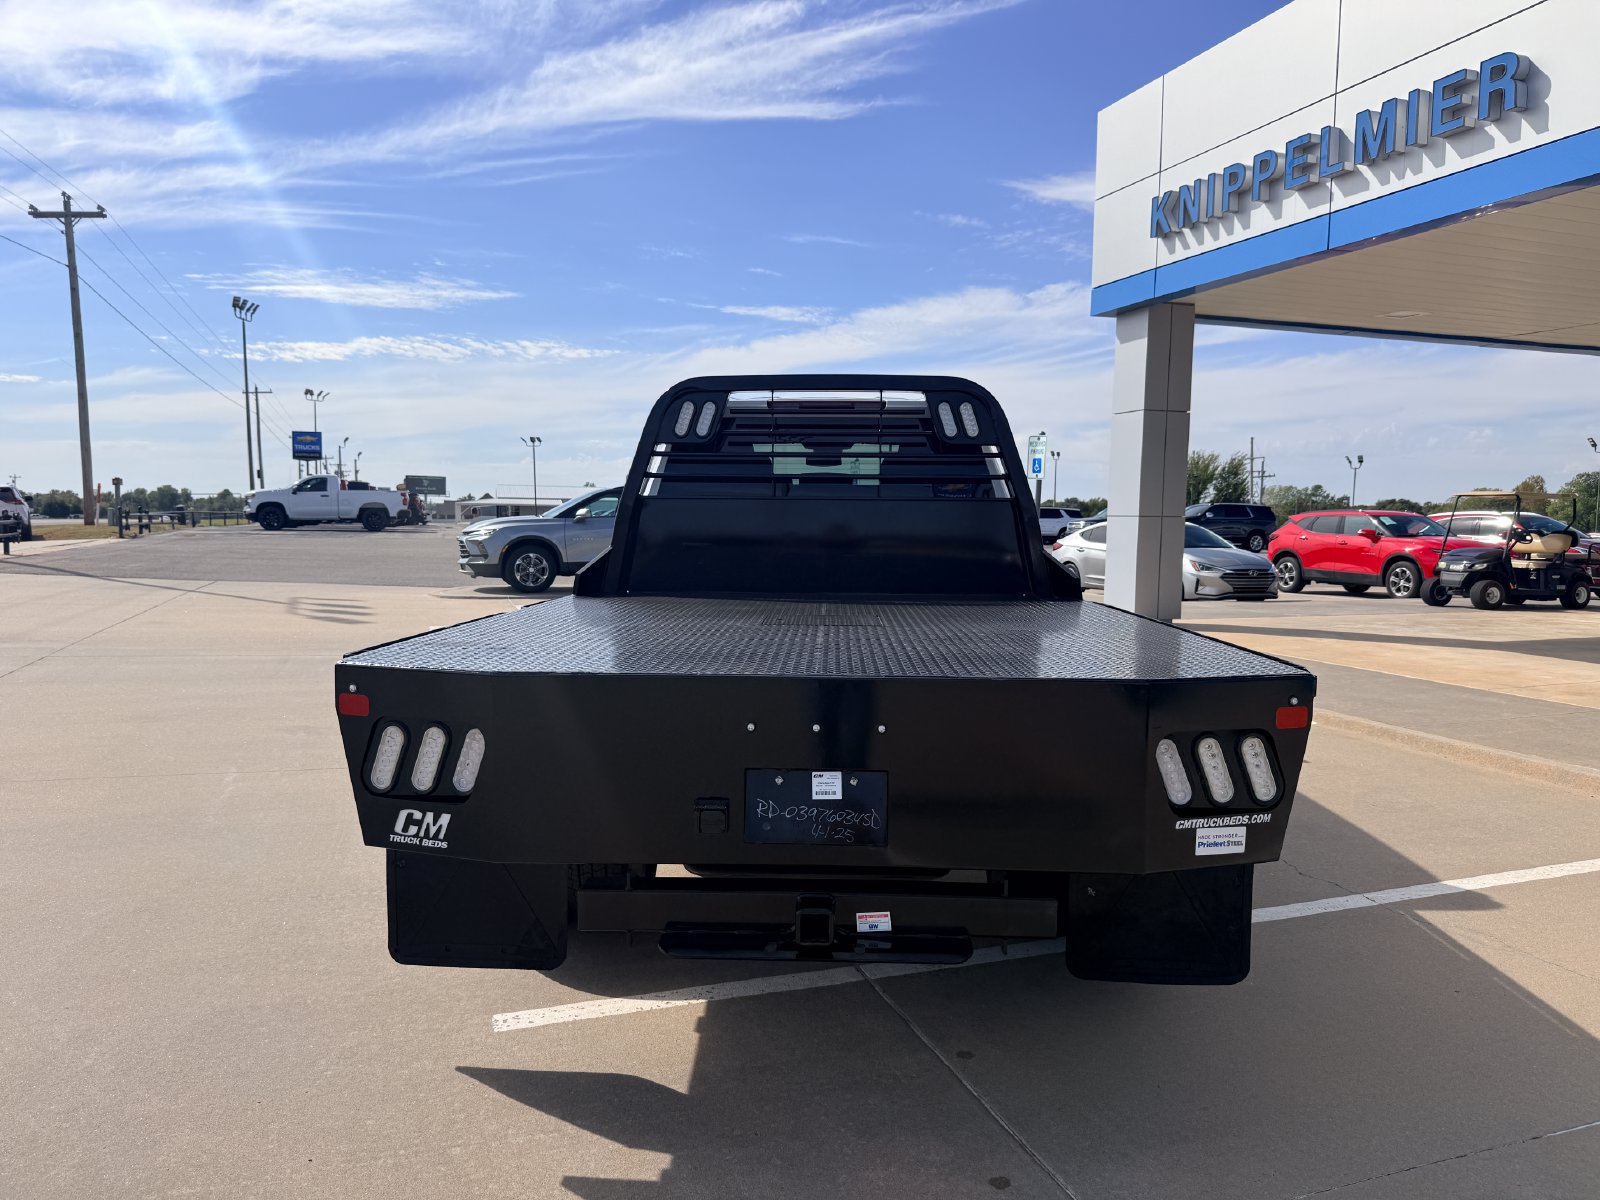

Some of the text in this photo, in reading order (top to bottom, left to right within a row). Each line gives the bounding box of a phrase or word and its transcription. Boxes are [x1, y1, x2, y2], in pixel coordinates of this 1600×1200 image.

[1150, 51, 1530, 239] KNIPPELMIER
[394, 809, 451, 840] CM
[1175, 814, 1272, 829] CMTRUCKBEDS.COM
[389, 834, 448, 849] TRUCK BEDS
